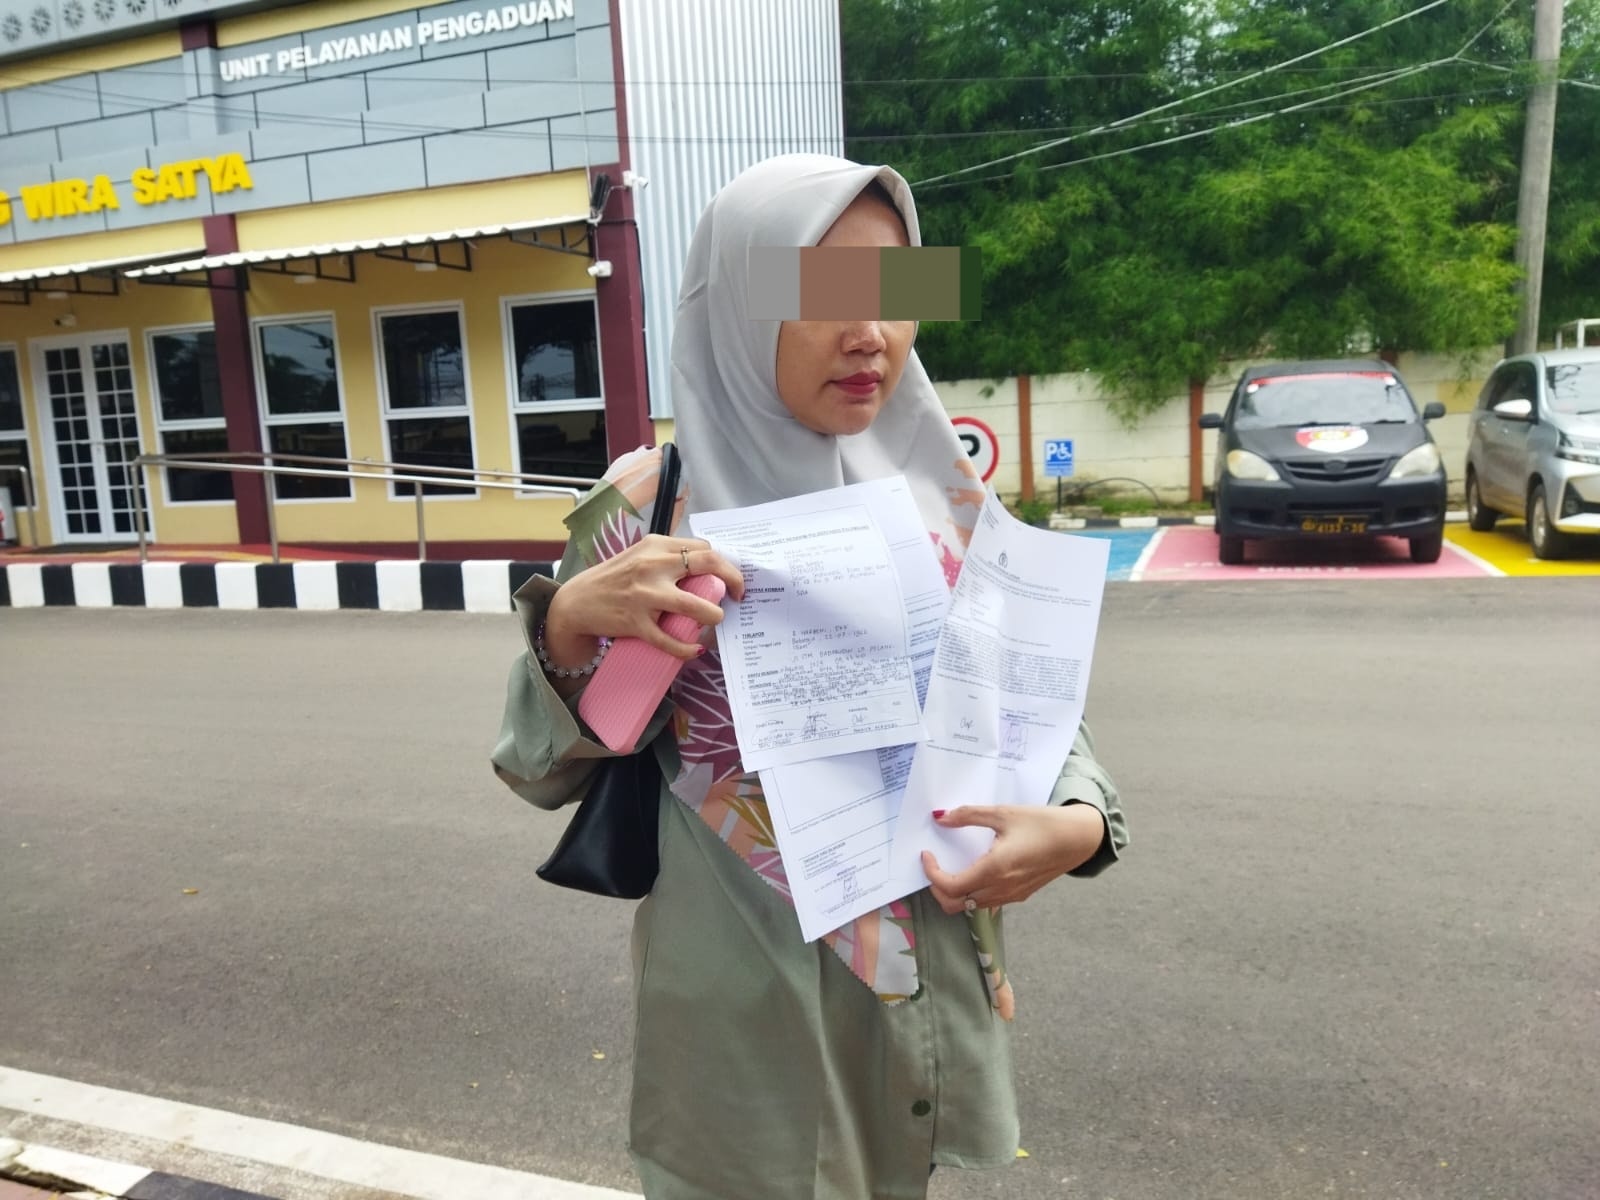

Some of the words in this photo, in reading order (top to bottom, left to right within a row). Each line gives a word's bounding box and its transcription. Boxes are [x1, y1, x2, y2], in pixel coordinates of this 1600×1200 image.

[219, 53, 272, 82] UNIT
[276, 25, 413, 72] PELAYANAN
[417, 0, 574, 46] PENGADUAN
[20, 174, 120, 221] WIRA
[131, 152, 254, 206] SATYA
[1046, 442, 1058, 460] P
